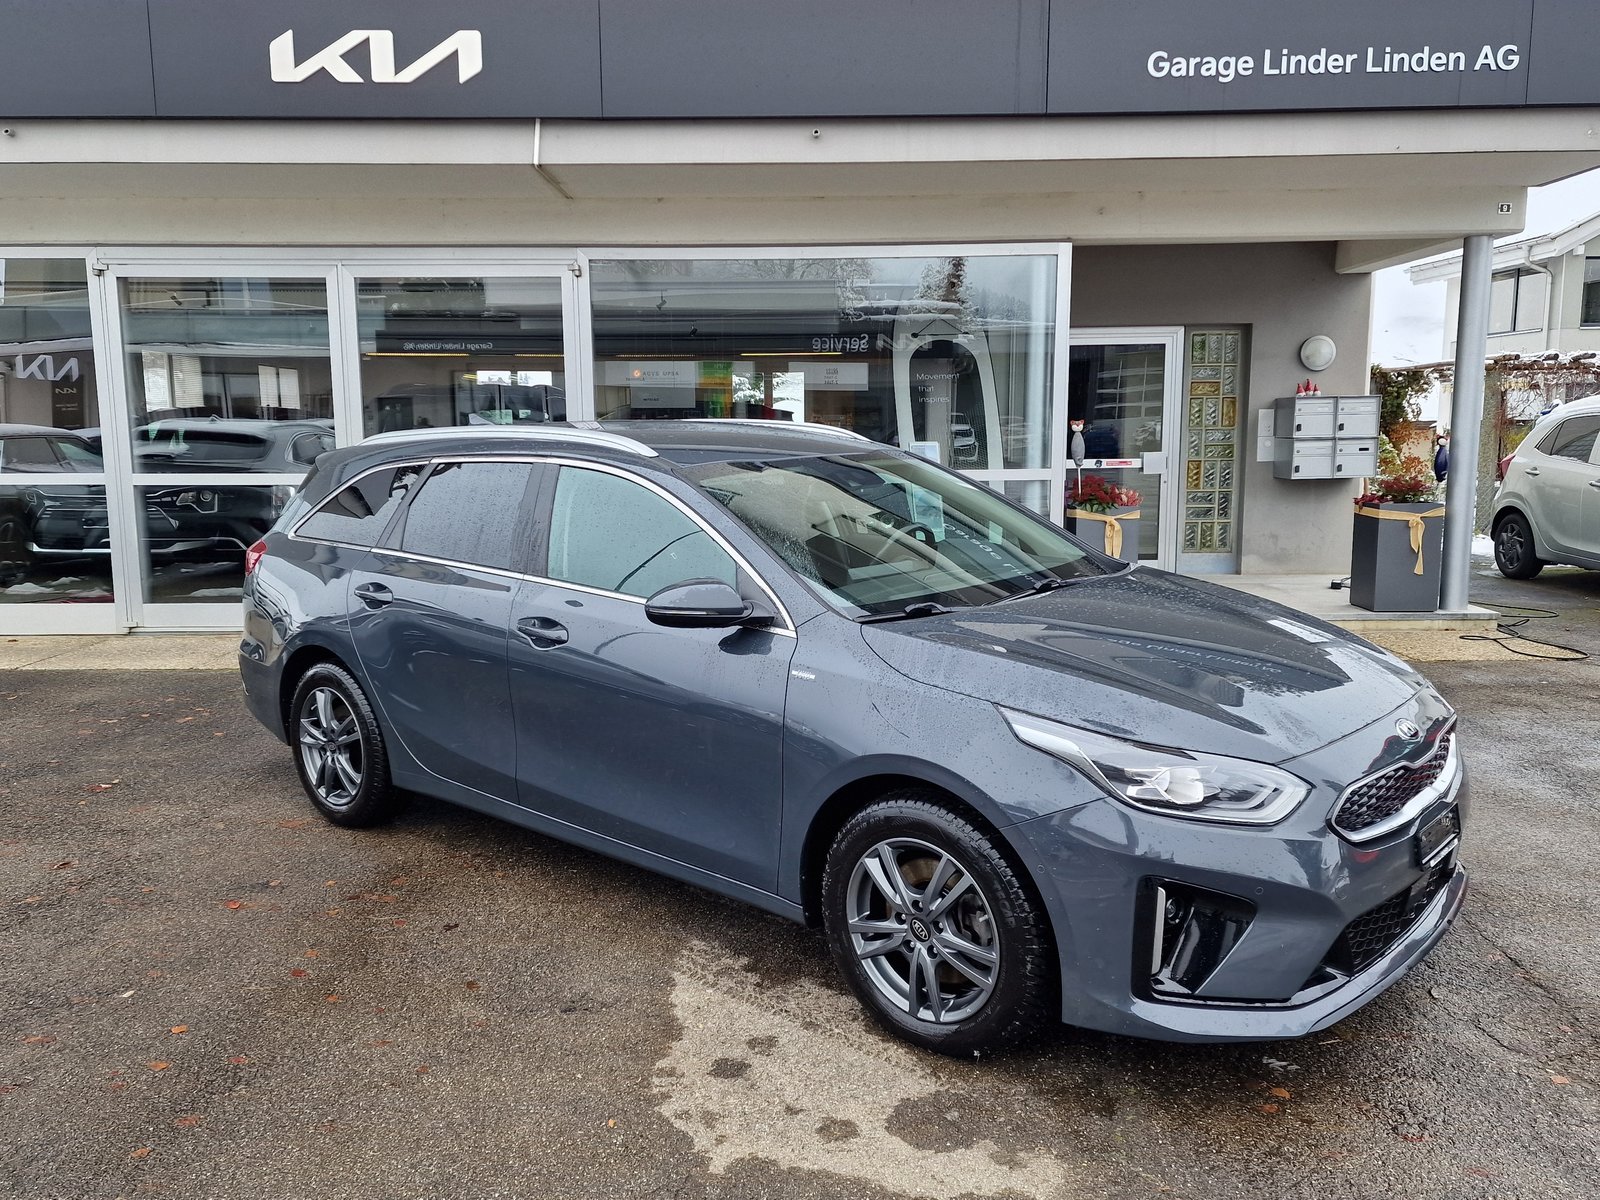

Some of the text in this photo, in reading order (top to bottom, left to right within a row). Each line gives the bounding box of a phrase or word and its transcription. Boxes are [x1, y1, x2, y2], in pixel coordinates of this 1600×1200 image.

[269, 28, 483, 85] KIA
[1146, 44, 1520, 83] Garage Linder Linden AG
[916, 372, 960, 381] Movement
[918, 395, 950, 404] inspires
[913, 921, 927, 939] KIA
